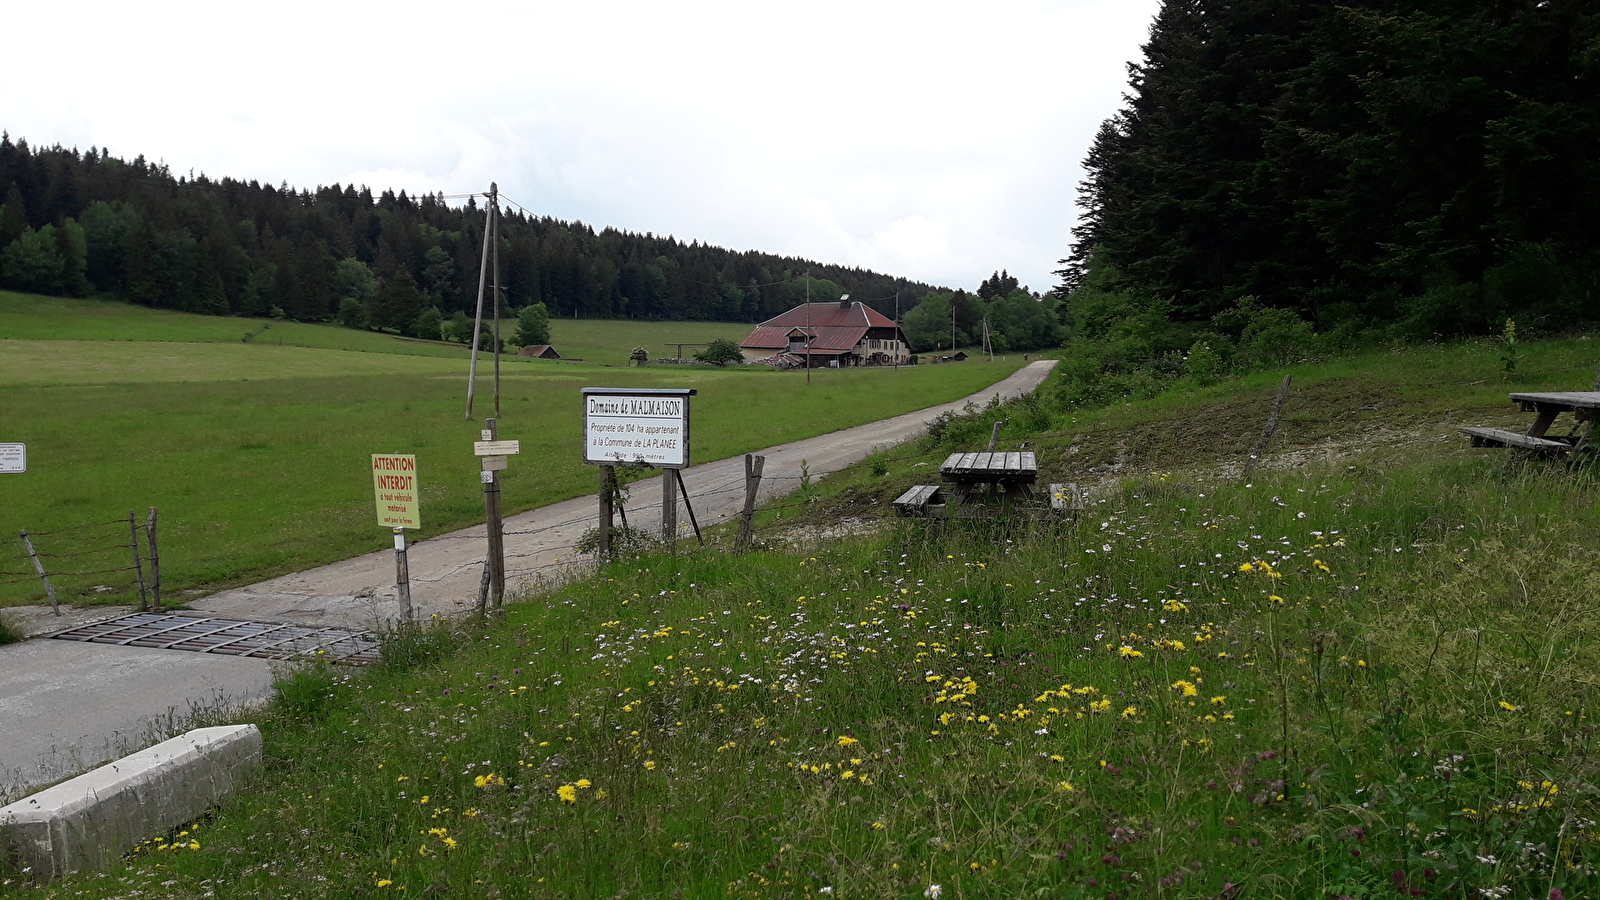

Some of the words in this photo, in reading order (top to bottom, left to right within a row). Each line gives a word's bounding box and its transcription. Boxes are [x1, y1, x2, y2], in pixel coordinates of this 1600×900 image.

[590, 399, 618, 414] Domaine
[621, 399, 628, 414] de
[630, 400, 680, 416] MALMAISON
[590, 422, 616, 434] Propriété
[617, 423, 624, 432] de
[626, 424, 635, 432] 104
[637, 424, 644, 433] ha
[645, 426, 679, 435] appartenant
[593, 438, 596, 446] à
[598, 437, 603, 446] la
[604, 437, 632, 448] Commune
[634, 439, 641, 448] de
[643, 439, 651, 448] LA
[604, 451, 628, 459] Altde:
[374, 457, 414, 471] ATTENTION
[378, 475, 412, 490] INTERDIT
[380, 492, 384, 500] à
[394, 492, 412, 502] véhicule
[388, 504, 406, 513] motorisé
